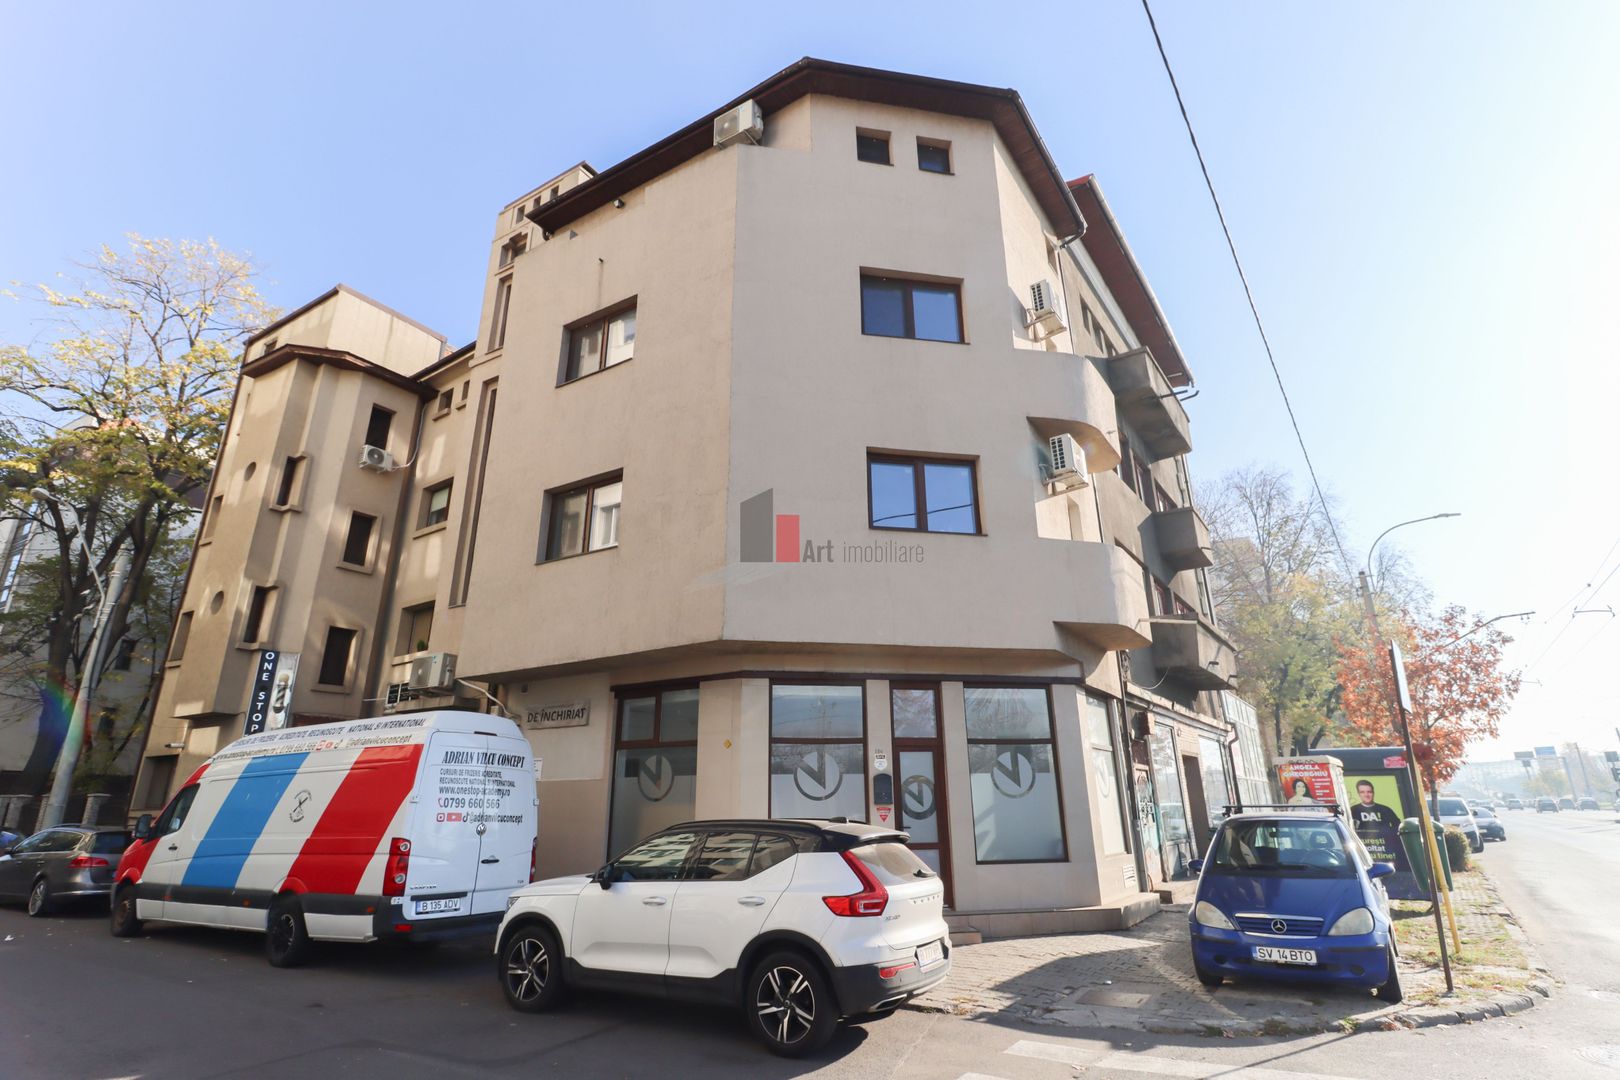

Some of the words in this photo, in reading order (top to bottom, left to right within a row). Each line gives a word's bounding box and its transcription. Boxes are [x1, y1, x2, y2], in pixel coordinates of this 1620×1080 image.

[262, 651, 276, 681] ONE
[250, 691, 266, 732] STOP
[527, 711, 540, 723] DE
[381, 718, 427, 729] INTERNATIONAL
[442, 751, 475, 765] ADRIAN
[497, 753, 526, 769] CONCEPT
[439, 786, 511, 799] www.onestop-academy.ro
[443, 797, 466, 809] 0799
[468, 798, 483, 809] 660
[485, 798, 500, 809] 566
[1360, 811, 1382, 822] DA!
[422, 901, 428, 911] B
[430, 900, 442, 910] 135
[1258, 948, 1273, 959] SV
[1277, 950, 1288, 960] 14
[1289, 950, 1313, 962] BTO
